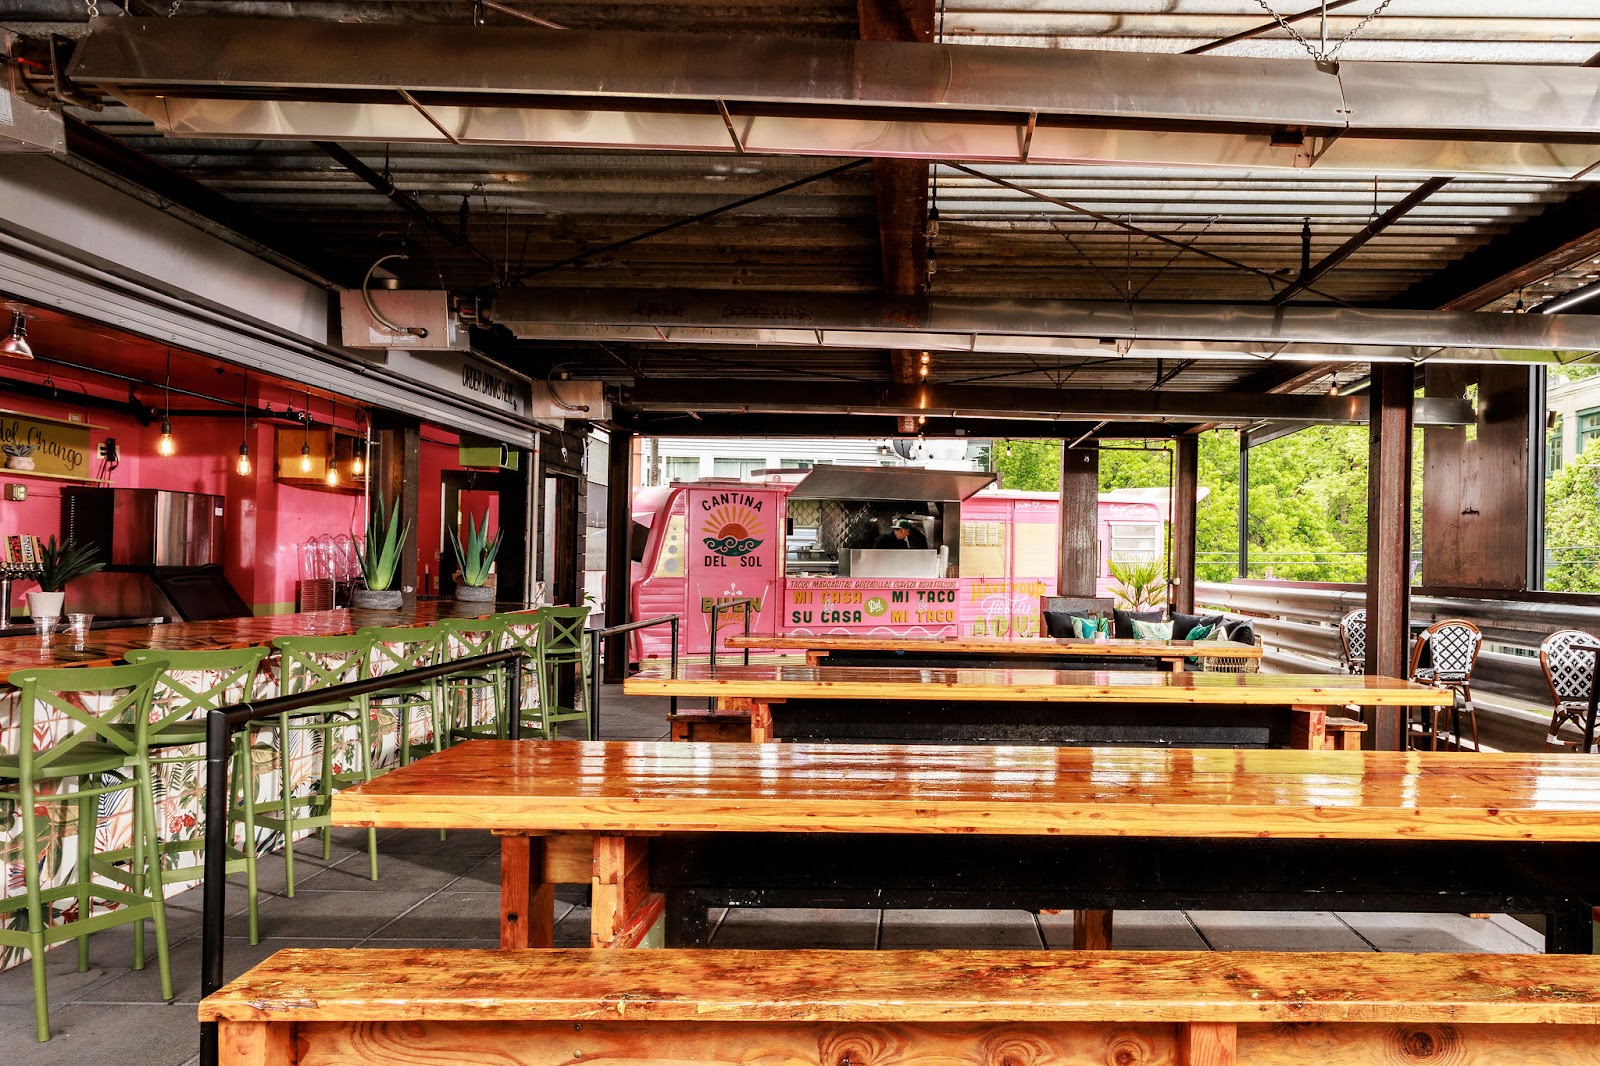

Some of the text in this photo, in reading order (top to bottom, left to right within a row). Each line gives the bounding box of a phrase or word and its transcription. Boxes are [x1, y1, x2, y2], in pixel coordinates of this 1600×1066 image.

[462, 363, 482, 392] ORDER
[28, 427, 83, 471] Chango
[701, 492, 763, 512] CANTINA
[704, 555, 762, 567] DEL SOL
[790, 581, 957, 589] TACOS MARGARITAS QUESADILLAS CERVEZA AGUA FRESCAS
[793, 591, 863, 604] MI CASA
[892, 590, 955, 603] MI TACO
[971, 582, 1008, 604] HAVE
[702, 597, 762, 613] BUEN
[792, 610, 863, 624] SU CASA
[891, 609, 955, 623] MI TACO
